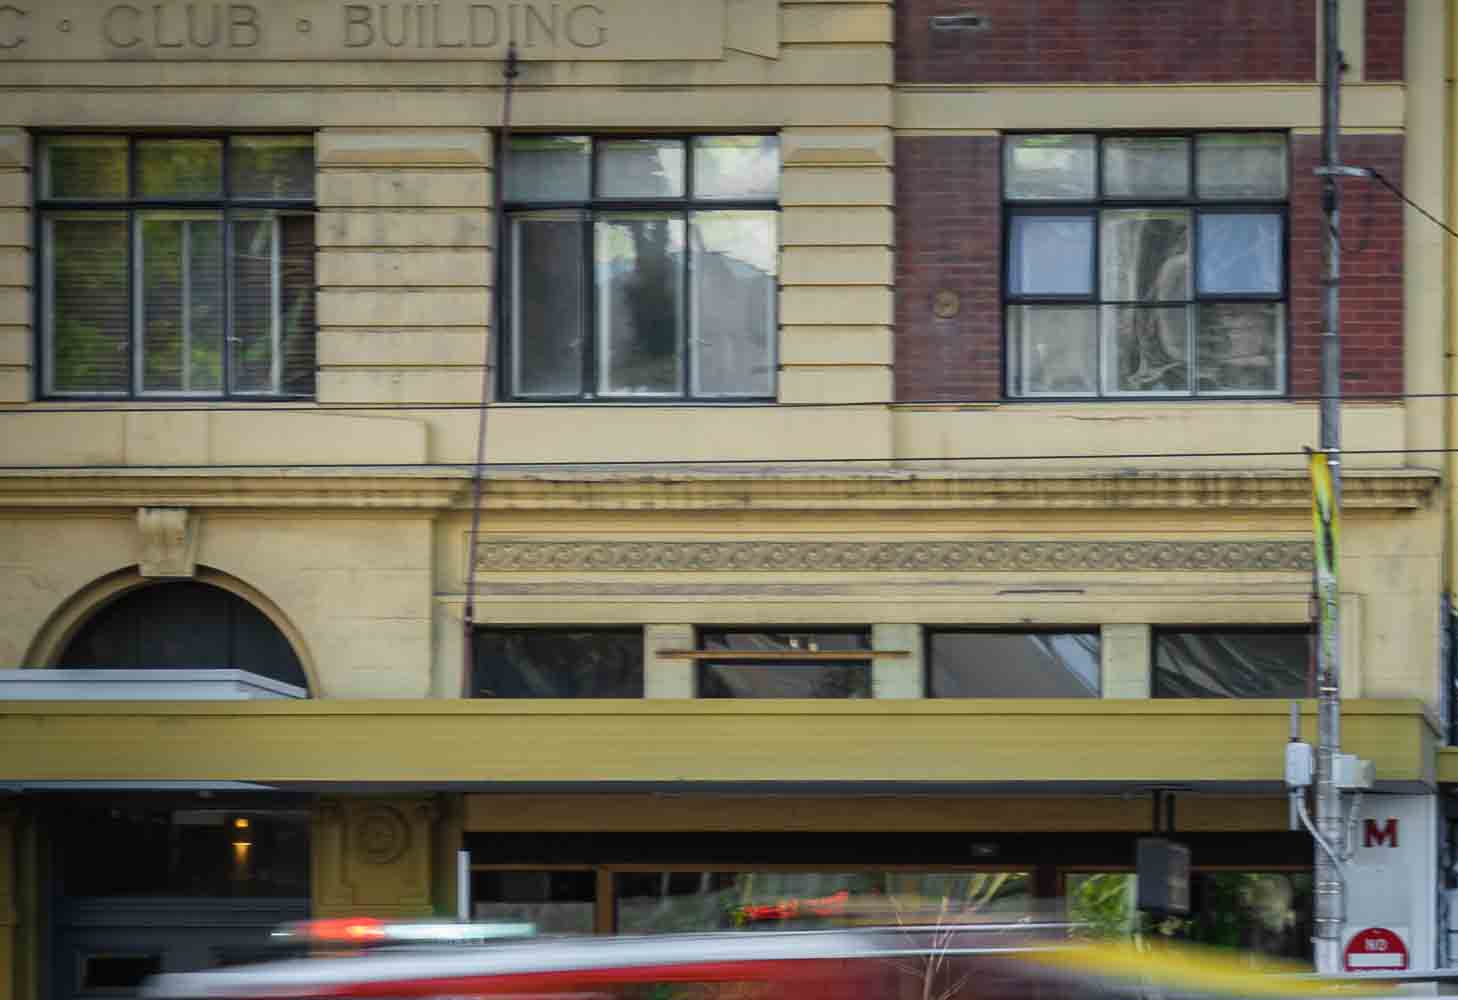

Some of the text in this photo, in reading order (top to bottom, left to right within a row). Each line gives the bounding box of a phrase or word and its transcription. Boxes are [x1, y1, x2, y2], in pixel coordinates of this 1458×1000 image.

[102, 4, 262, 49] CLUB
[343, 4, 609, 49] BUILDING
[1362, 818, 1400, 849] M
